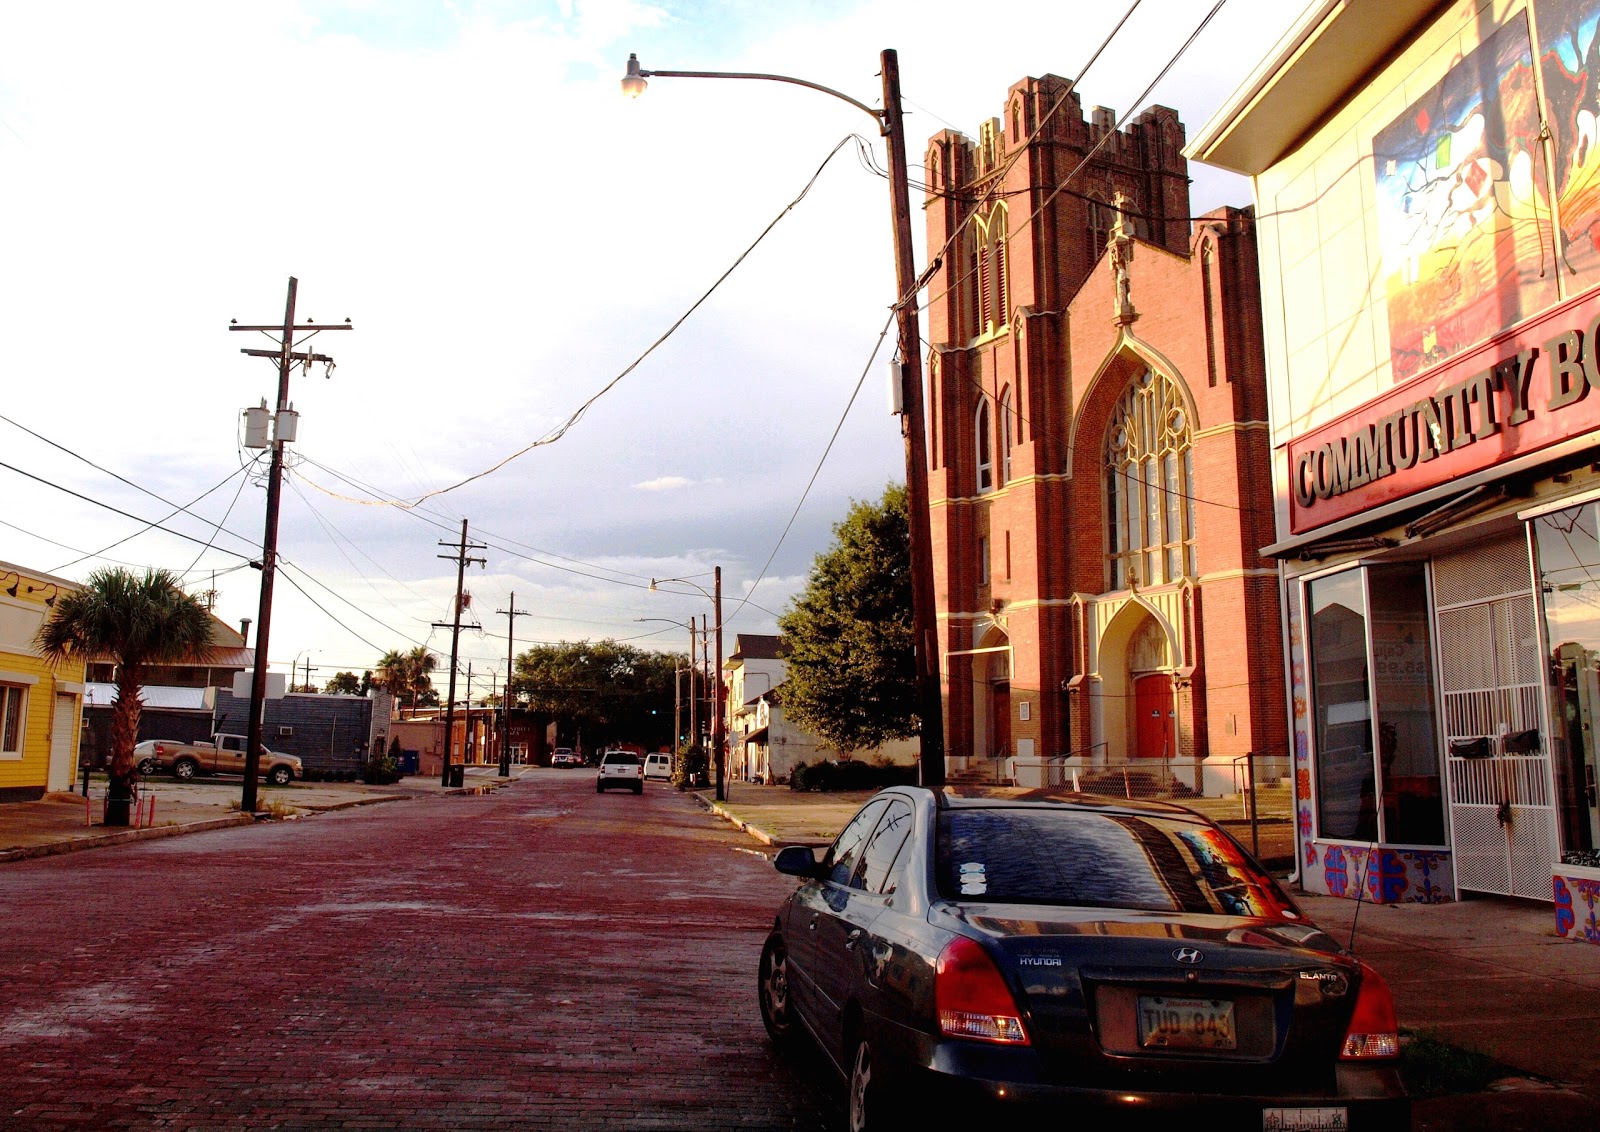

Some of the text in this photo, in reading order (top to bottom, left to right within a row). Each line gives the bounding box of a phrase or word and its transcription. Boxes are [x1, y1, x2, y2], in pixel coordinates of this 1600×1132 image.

[1294, 348, 1539, 507] COMMUNITY
[1020, 957, 1062, 967] HYUNDAI
[1299, 971, 1338, 982] ELANTR
[1143, 1009, 1180, 1035] TUD
